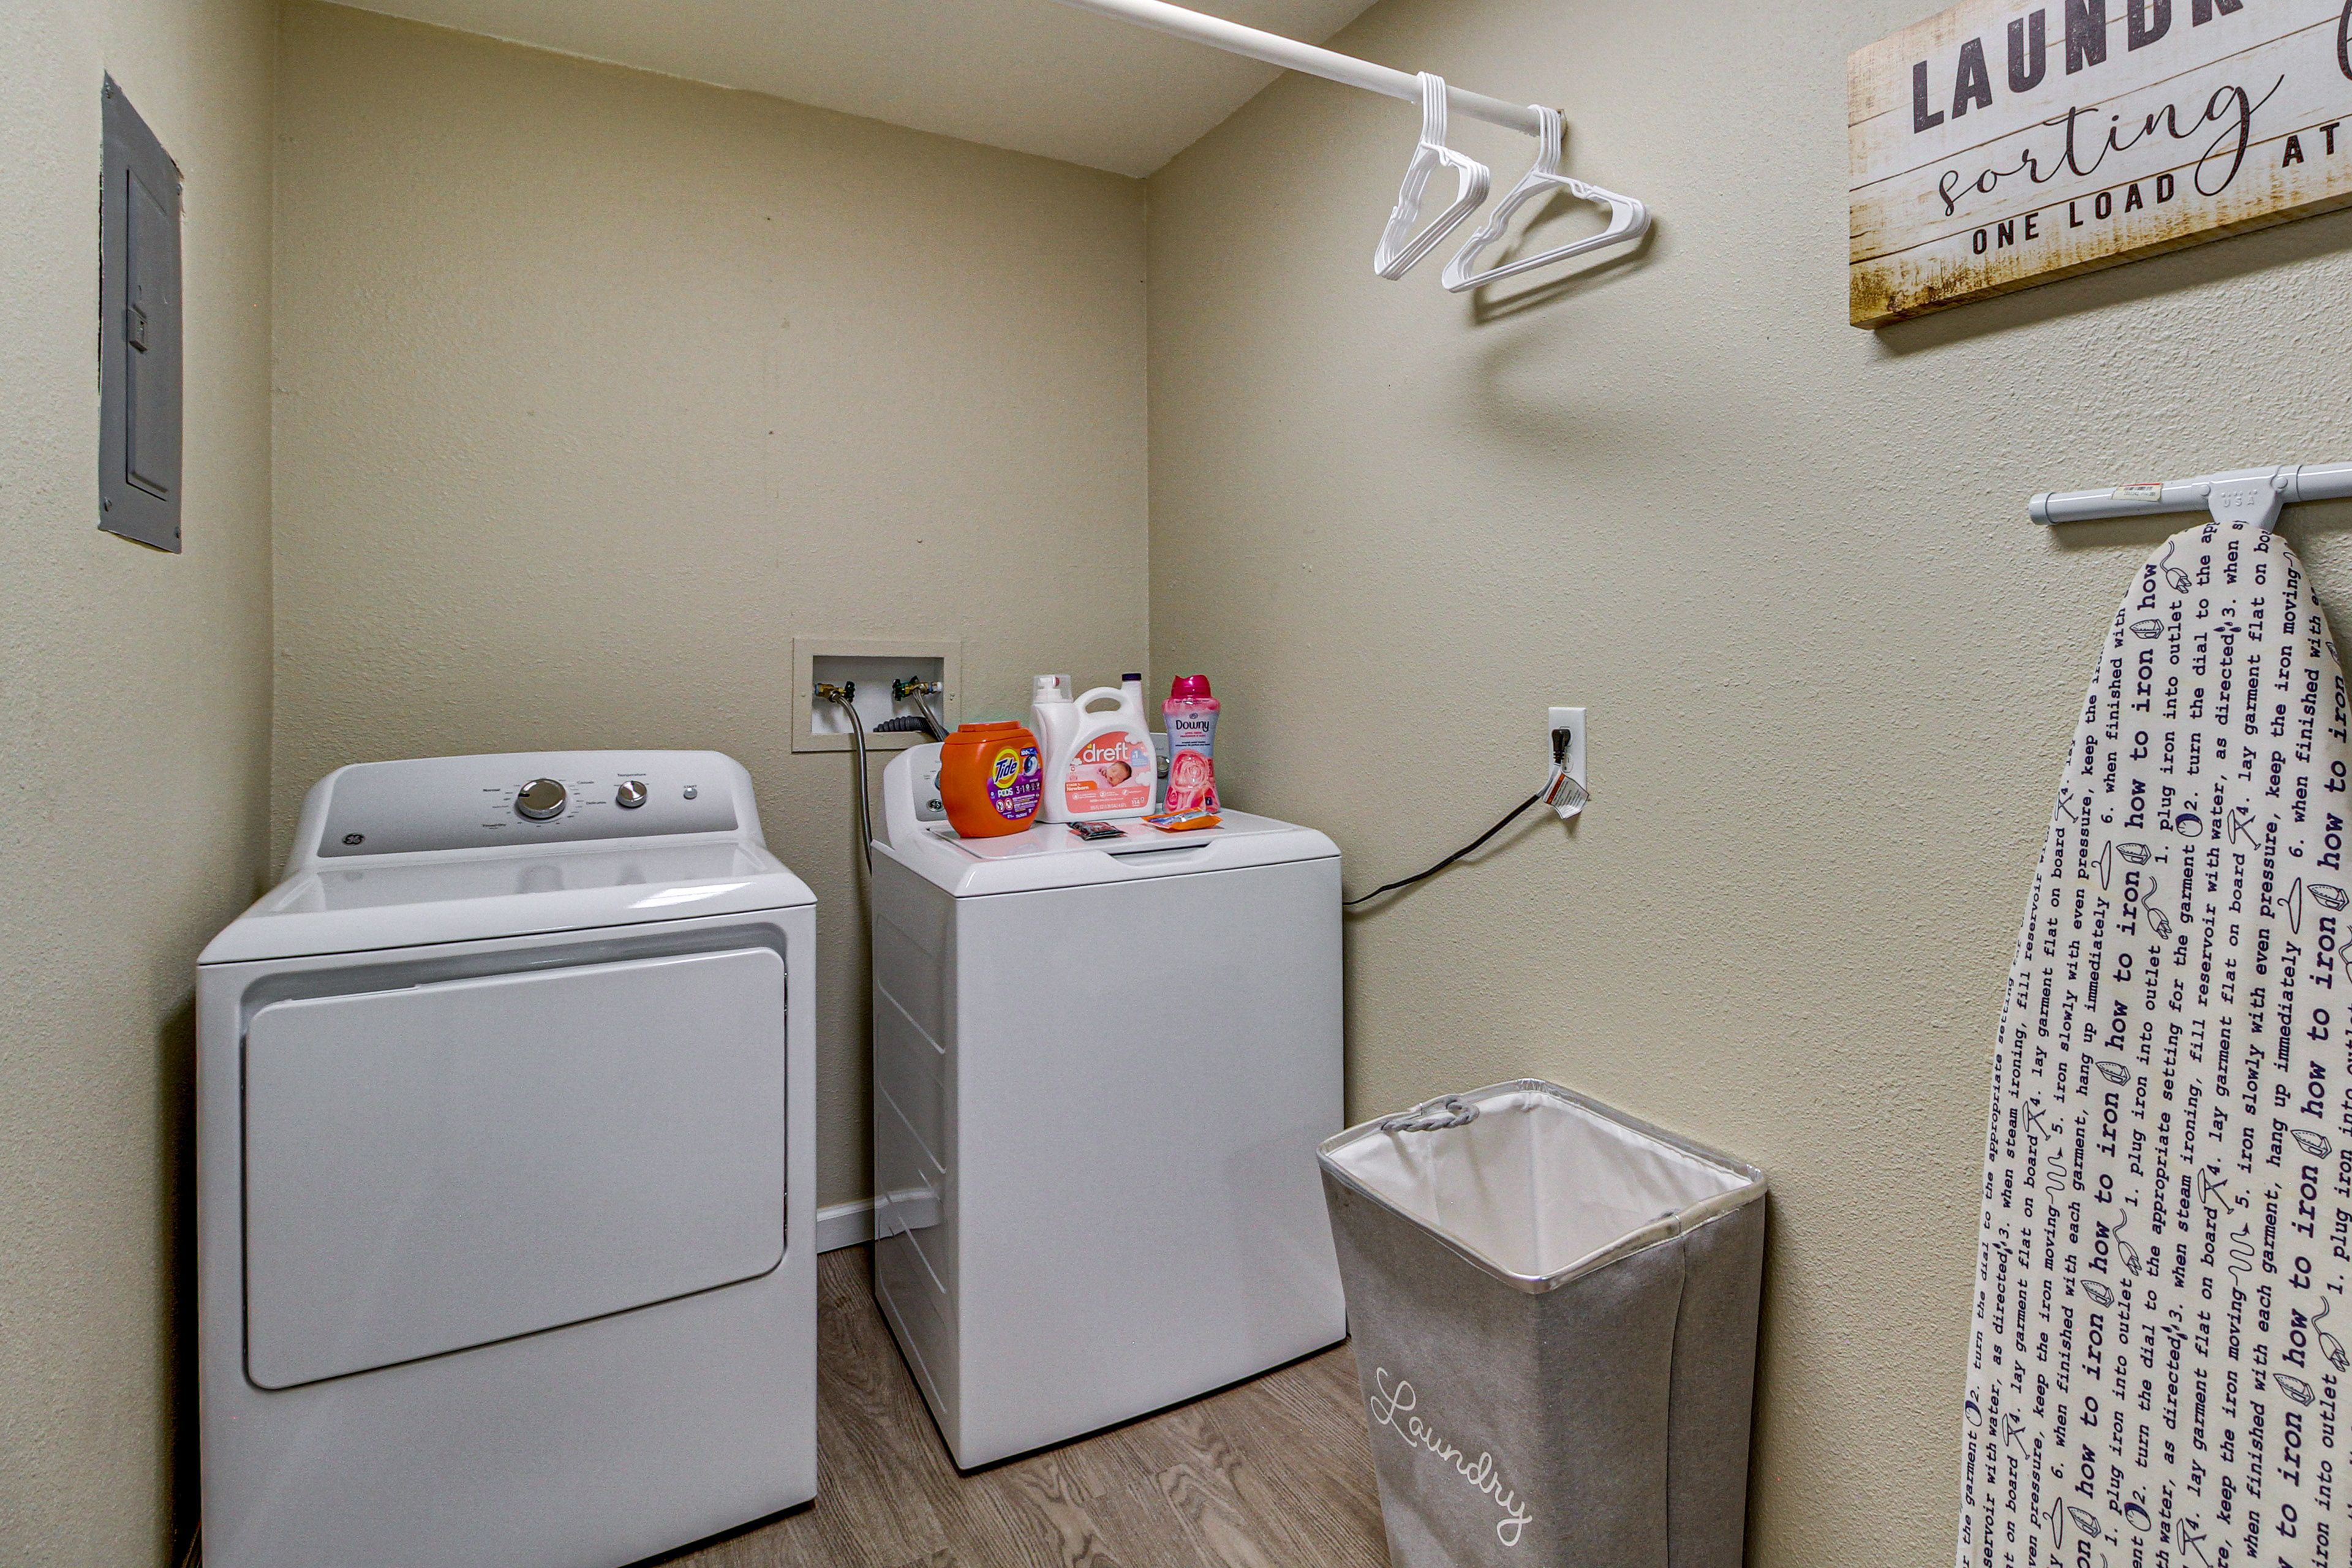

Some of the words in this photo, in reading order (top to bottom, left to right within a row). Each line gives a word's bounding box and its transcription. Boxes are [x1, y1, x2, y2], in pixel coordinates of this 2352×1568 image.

[1939, 74, 2285, 217] sorting
[1972, 213, 2040, 255] ONE
[2069, 173, 2174, 228] LOAD
[2282, 121, 2341, 168] AT
[2196, 555, 2211, 586] the
[2223, 540, 2239, 584] when
[2137, 564, 2157, 611] how
[2196, 598, 2209, 619] to
[2222, 600, 2236, 617] 3.
[2282, 568, 2301, 635] moving
[2113, 608, 2125, 649] with
[2168, 600, 2182, 665] outlet
[2192, 632, 2207, 676] dial
[2274, 646, 2292, 692] iron
[2106, 658, 2122, 740] finished
[2132, 649, 2153, 712] iron
[2165, 676, 2178, 719] into
[2214, 635, 2234, 725] directed
[1175, 719, 1210, 733] Downy
[2190, 688, 2204, 719] the
[2271, 704, 2286, 737] the
[2328, 676, 2346, 744] iron
[1083, 742, 1128, 763] dreft
[2130, 731, 2149, 761] to
[2160, 731, 2175, 774] iron
[2187, 733, 2201, 775] turn
[2216, 738, 2227, 760] as
[994, 758, 1018, 785] Tide
[997, 788, 1013, 797] PODS
[2060, 780, 2070, 796] 4.
[2103, 752, 2117, 793] when
[2265, 751, 2286, 798] keep
[2324, 761, 2346, 793] to
[2101, 808, 2114, 823] 6.
[2124, 778, 2146, 829] how
[2157, 785, 2176, 832] plug
[2184, 792, 2198, 812] 2.
[2210, 775, 2227, 840] water,
[2051, 827, 2065, 879] board
[2154, 846, 2168, 864] 1.
[2317, 813, 2343, 870] how
[2180, 845, 2195, 923] garment
[2205, 848, 2220, 892] with
[2260, 813, 2281, 919] pressure,
[2051, 888, 2060, 907] on
[2116, 871, 2139, 936] iron
[2044, 918, 2058, 957] flat
[2084, 897, 2109, 1012] immediately
[2173, 935, 2188, 966] the
[2198, 903, 2216, 1007] reservoir
[2256, 929, 2270, 975] even
[2309, 917, 2336, 989] iron
[2113, 953, 2133, 982] to
[2145, 945, 2160, 1011] outlet
[2038, 968, 2052, 1037] garment
[2169, 979, 2184, 1012] for
[2248, 987, 2265, 1033] with
[2084, 1023, 2097, 1042] up
[2105, 1000, 2128, 1051] how
[2136, 1022, 2153, 1065] into
[2190, 1020, 2205, 1063] fill
[2307, 1008, 2330, 1041] to
[2032, 1046, 2047, 1077] lay
[2076, 1052, 2094, 1096] hang
[2162, 1023, 2183, 1101] setting
[2242, 1044, 2264, 1115] slowly
[2030, 1091, 2041, 1107] 4.
[2135, 1077, 2147, 1120] iron
[2301, 1060, 2326, 1119] how
[2097, 1093, 2119, 1158] iron
[2184, 1078, 2202, 1164] ironing,
[2023, 1135, 2038, 1188] board
[2073, 1110, 2089, 1191] garment,
[2128, 1129, 2146, 1177] plug
[2237, 1128, 2254, 1174] iron
[2094, 1174, 2113, 1204] to
[2152, 1112, 2171, 1235] appropriate
[2334, 1150, 2352, 1198] iron
[2024, 1197, 2033, 1218] on
[2125, 1189, 2138, 1207] 1.
[2176, 1175, 2192, 1232] steam
[2235, 1190, 2250, 1208] 5.
[2291, 1166, 2318, 1238] iron
[1966, 1431, 1977, 1506] garment
[1973, 1331, 1983, 1370] turn
[1984, 1212, 1991, 1229] to
[1989, 1054, 2002, 1162] appropriate
[1999, 978, 2014, 1044] setting
[2068, 1202, 2080, 1243] each
[2330, 1208, 2352, 1262] plug
[2018, 1227, 2031, 1269] flat
[2089, 1221, 2109, 1274] how
[2146, 1246, 2160, 1276] the
[2172, 1243, 2187, 1288] when
[2064, 1255, 2076, 1296] with
[2288, 1256, 2312, 1289] to
[2016, 1278, 2027, 1352] garment
[2118, 1278, 2132, 1344] outlet
[2144, 1290, 2157, 1310] to
[2169, 1304, 2183, 1322] 3.
[2140, 1324, 2155, 1368] dial
[2228, 1287, 2247, 1361] moving
[2282, 1308, 2307, 1368] how
[2057, 1305, 2073, 1393] finished
[2082, 1313, 2103, 1381] iron
[2011, 1360, 2026, 1393] lay
[2114, 1355, 2127, 1401] into
[2138, 1379, 2152, 1411] the
[2162, 1338, 2181, 1430] directed
[2222, 1371, 2237, 1418] iron
[2009, 1409, 2021, 1424] 4.
[2053, 1404, 2067, 1447] when
[2080, 1396, 2098, 1427] to
[2320, 1374, 2337, 1448] outlet
[1370, 1366, 1532, 1547] Laundry
[2113, 1411, 2124, 1457] iron
[2135, 1425, 2149, 1468] turn
[2164, 1440, 2175, 1464] as
[2220, 1429, 2235, 1463] the
[2277, 1412, 2302, 1487] iron
[2005, 1455, 2018, 1513] board
[2051, 1463, 2064, 1479] 6.
[2075, 1444, 2095, 1499] how
[2106, 1464, 2124, 1516] plug
[2315, 1460, 2332, 1511] into
[2132, 1487, 2146, 1501] 2.
[2158, 1479, 2176, 1544] water,
[2217, 1476, 2236, 1525] keep
[2007, 1521, 2015, 1543] on
[2105, 1529, 2117, 1547] 1.
[2275, 1504, 2297, 1538] to
[2312, 1522, 2329, 1568] iron
